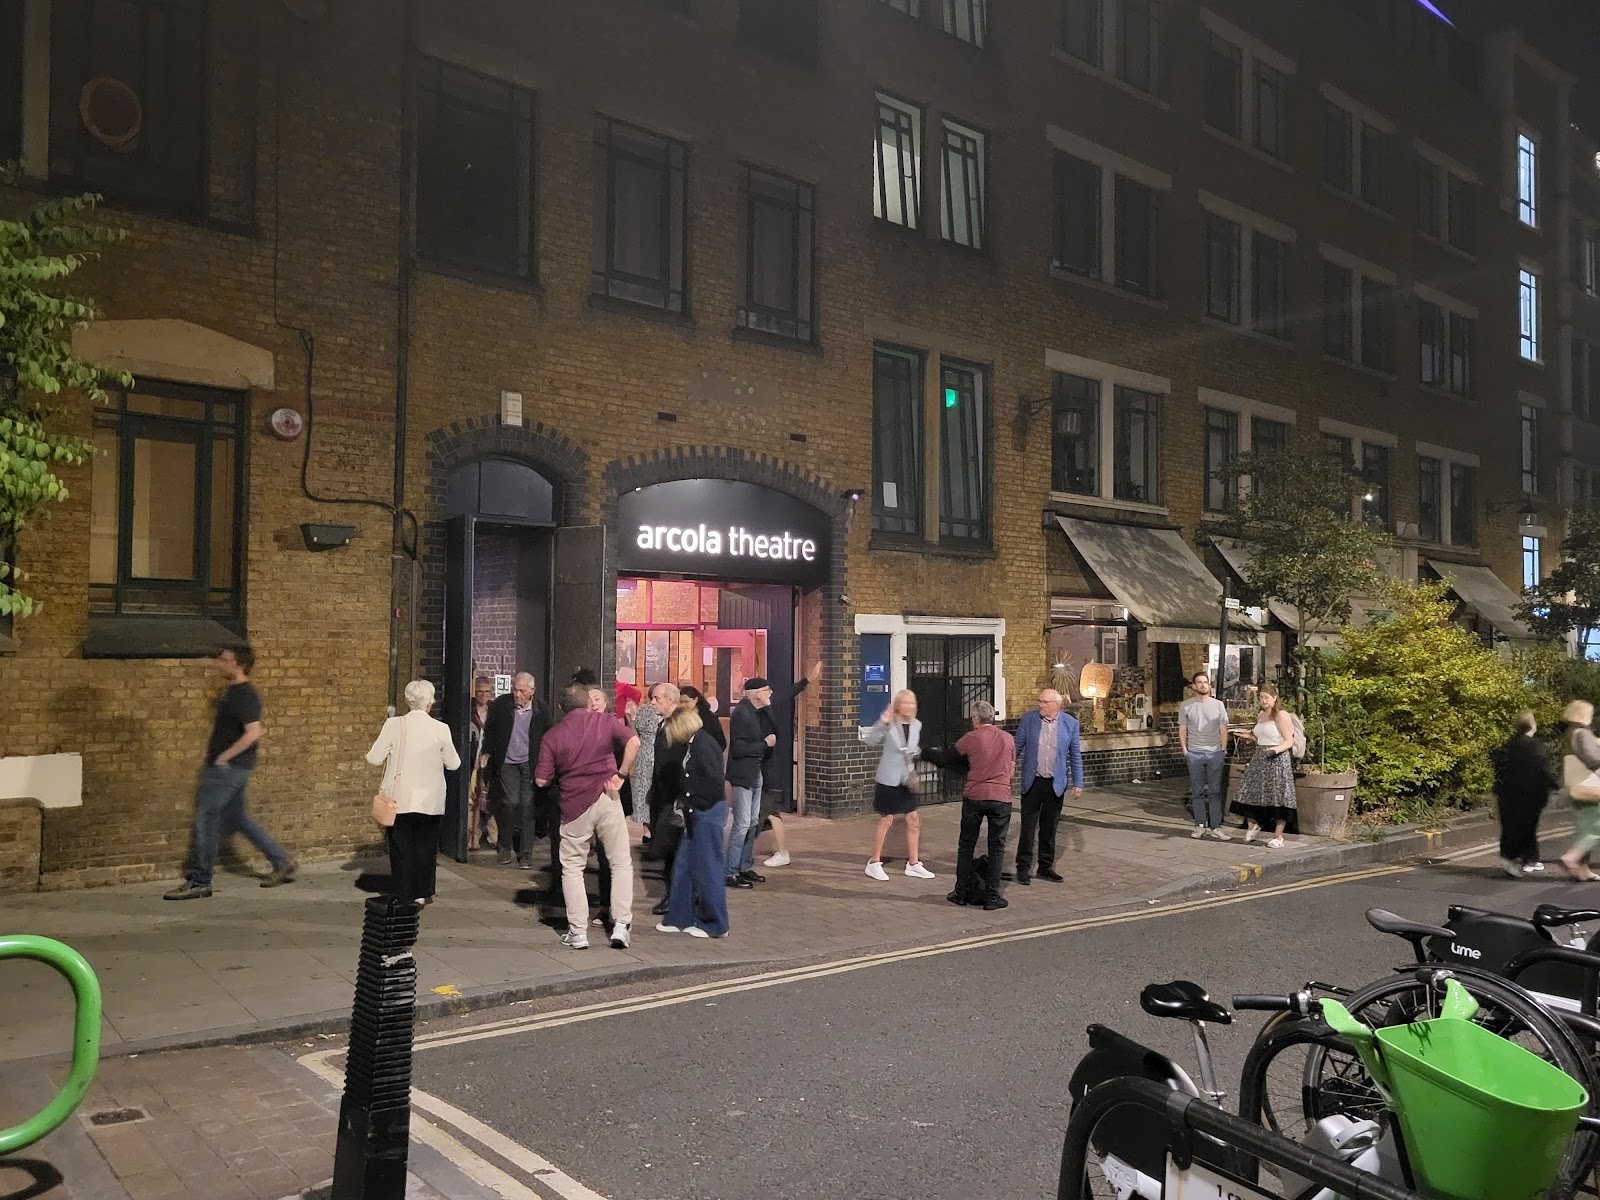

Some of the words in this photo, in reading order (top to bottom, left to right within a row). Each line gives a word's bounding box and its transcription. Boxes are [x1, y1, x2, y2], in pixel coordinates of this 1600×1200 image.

[637, 523, 722, 554] arcola
[728, 526, 816, 561] theatre
[1451, 942, 1482, 960] Lime
[1216, 1184, 1222, 1198] 1
